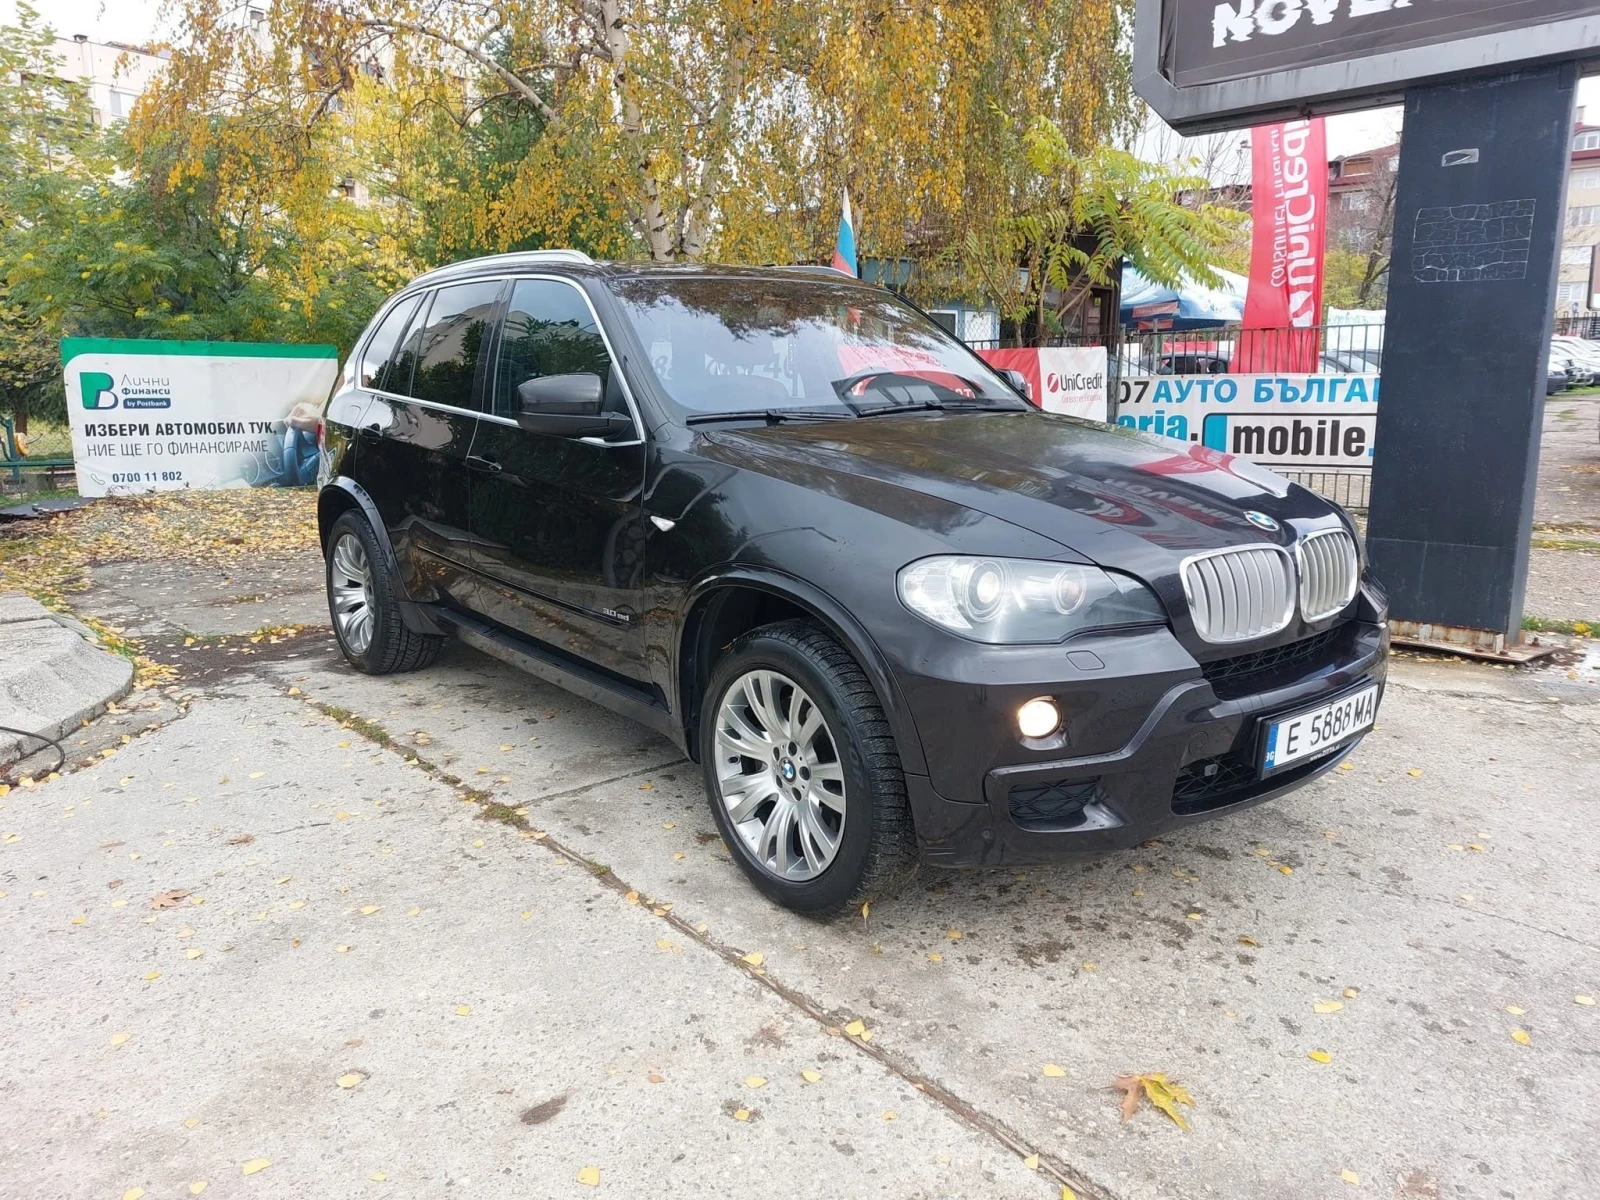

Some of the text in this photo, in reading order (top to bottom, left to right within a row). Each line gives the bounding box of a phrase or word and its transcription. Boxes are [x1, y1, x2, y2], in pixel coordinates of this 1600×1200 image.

[121, 374, 170, 386] Лични
[1060, 372, 1103, 391] UniCredit
[121, 387, 171, 396] Финанси
[1152, 378, 1238, 404] АУТО
[84, 421, 277, 437] ИЗБЕРИ АВТОМОБИЛ ТУК,
[86, 440, 269, 457] НИЕ ЩЕ ГО ФИНАНСИРАМЕ
[112, 470, 183, 483] 0700 11 802
[1286, 721, 1302, 755] E
[1310, 702, 1352, 746] 5888
[1353, 692, 1373, 728] MA
